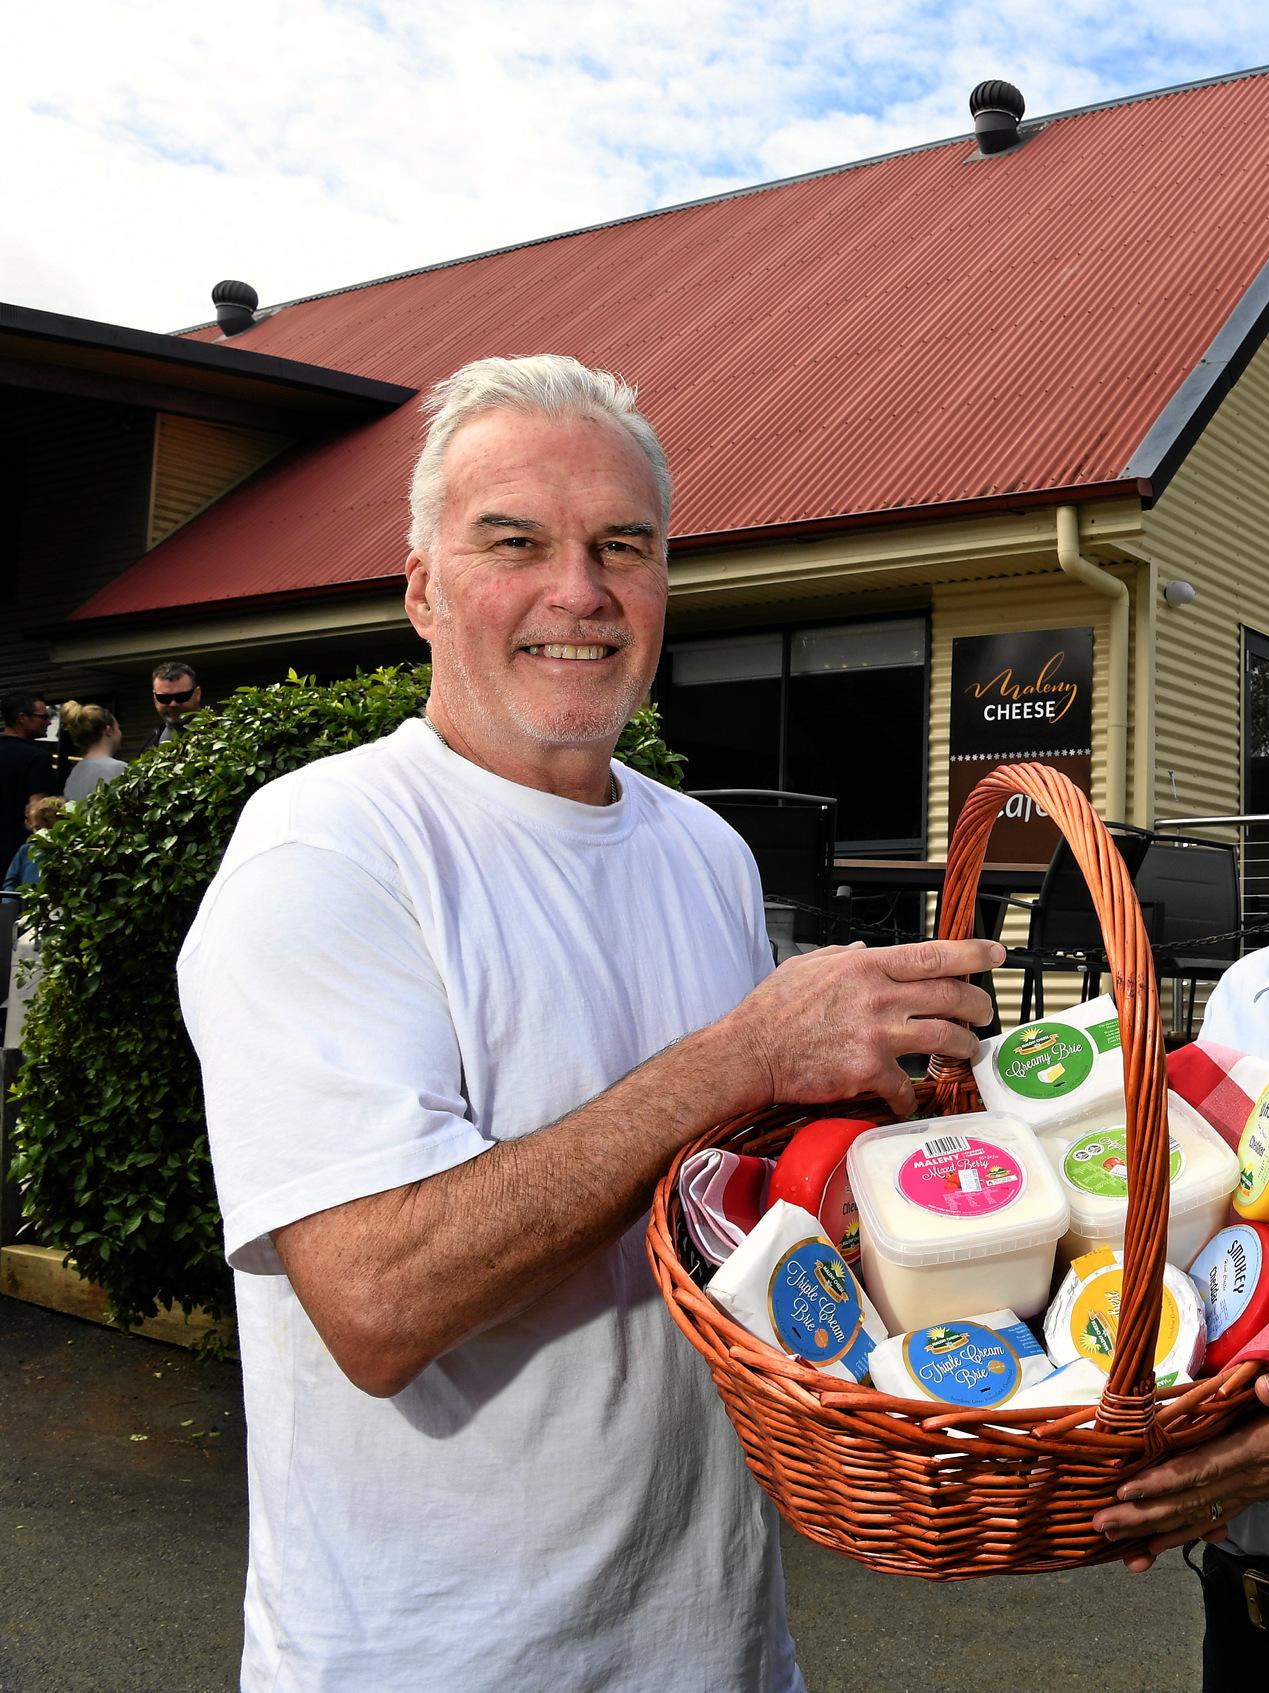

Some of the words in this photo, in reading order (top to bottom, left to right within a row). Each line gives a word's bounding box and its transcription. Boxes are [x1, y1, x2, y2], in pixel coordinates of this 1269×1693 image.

[964, 651, 1078, 724] Maleny
[983, 701, 1056, 722] CHEESE
[1005, 1051, 1052, 1078] Creamy
[1051, 1042, 1083, 1061] Brie
[913, 1153, 960, 1169] MALENY
[921, 1161, 957, 1180] Mixed
[956, 1158, 989, 1170] Berry
[1227, 1239, 1247, 1294] SMOKEY
[786, 1259, 820, 1302] Triple
[818, 1297, 846, 1344] Cream
[790, 1298, 816, 1333] Brie
[919, 1354, 962, 1384] Triple
[960, 1344, 1005, 1365] Cream
[955, 1368, 989, 1390] Brie
